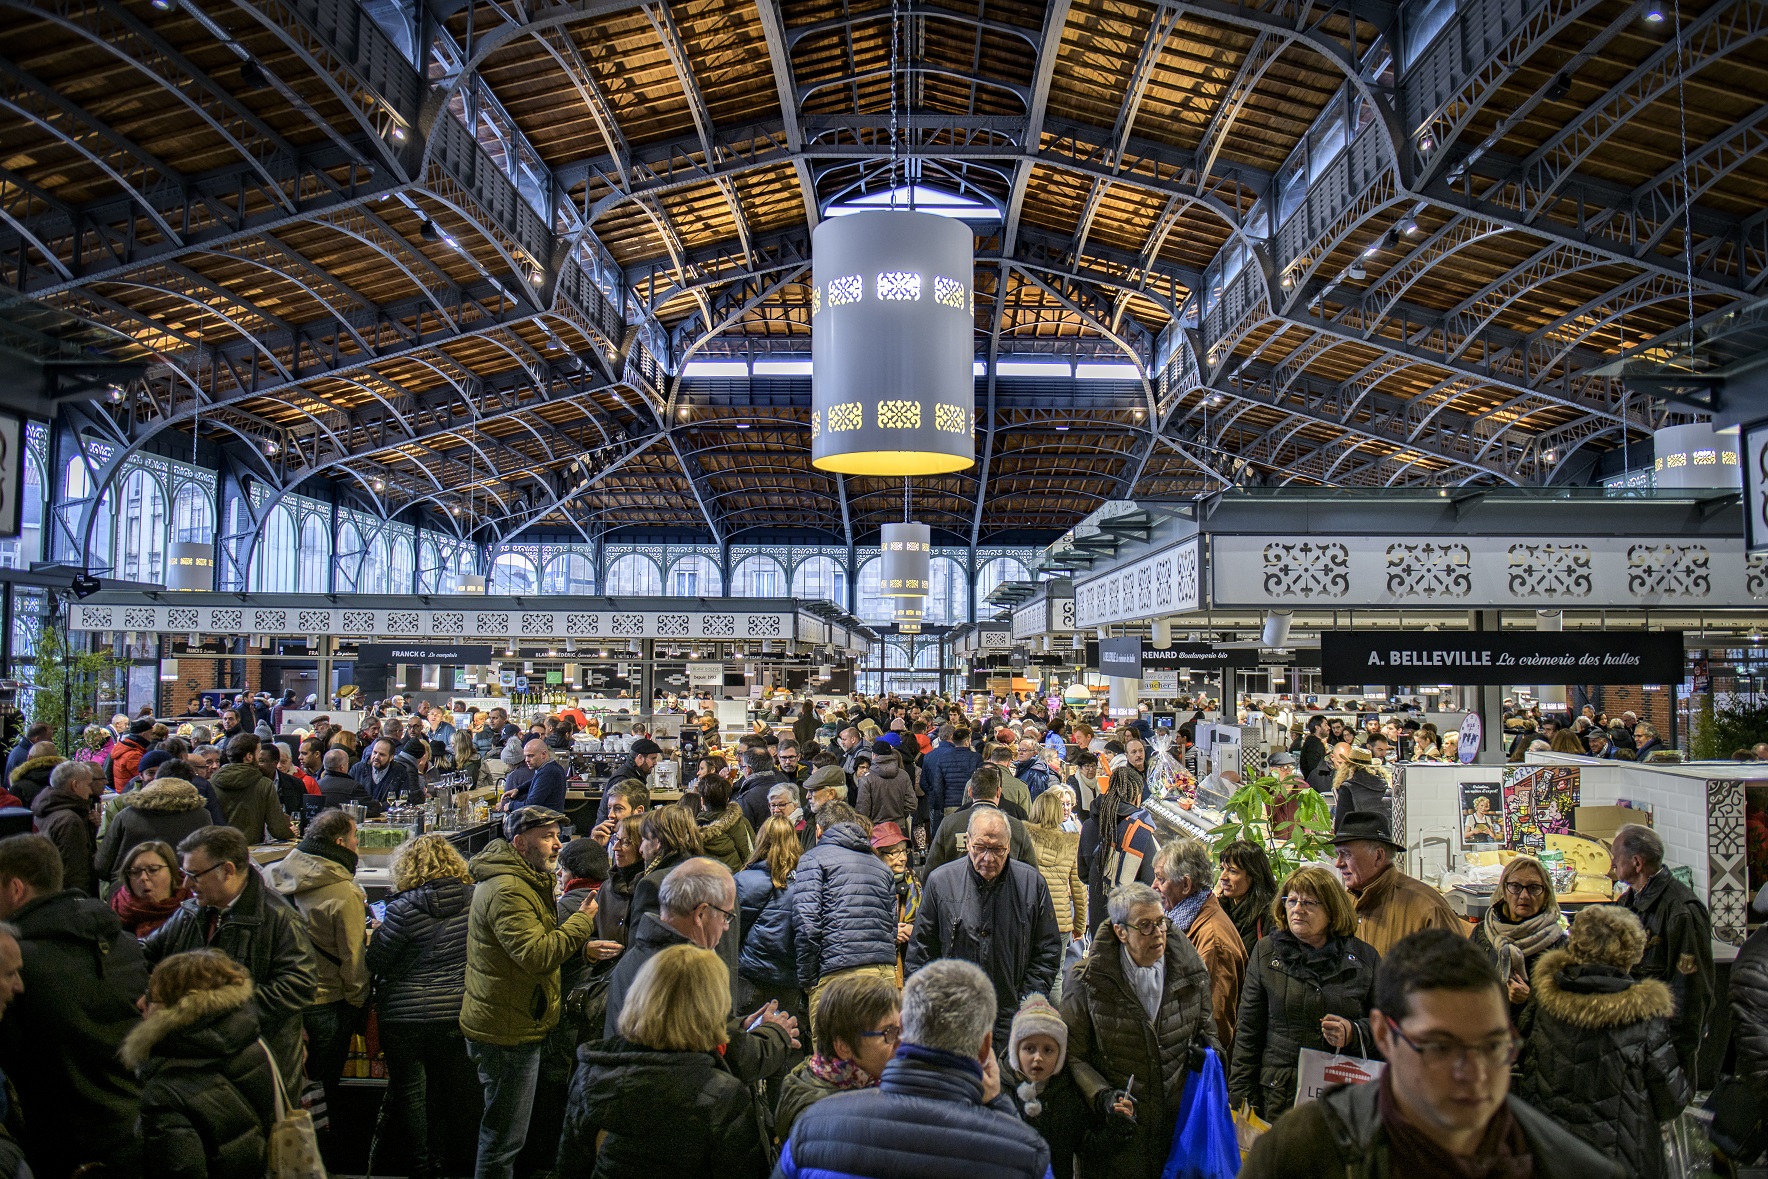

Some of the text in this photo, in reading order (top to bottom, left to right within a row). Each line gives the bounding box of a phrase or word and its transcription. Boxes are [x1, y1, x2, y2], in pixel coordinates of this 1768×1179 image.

[1178, 652, 1216, 660] Boulangerie
[1368, 651, 1640, 666] A. BELLEVILLE La crèmerie des halles
